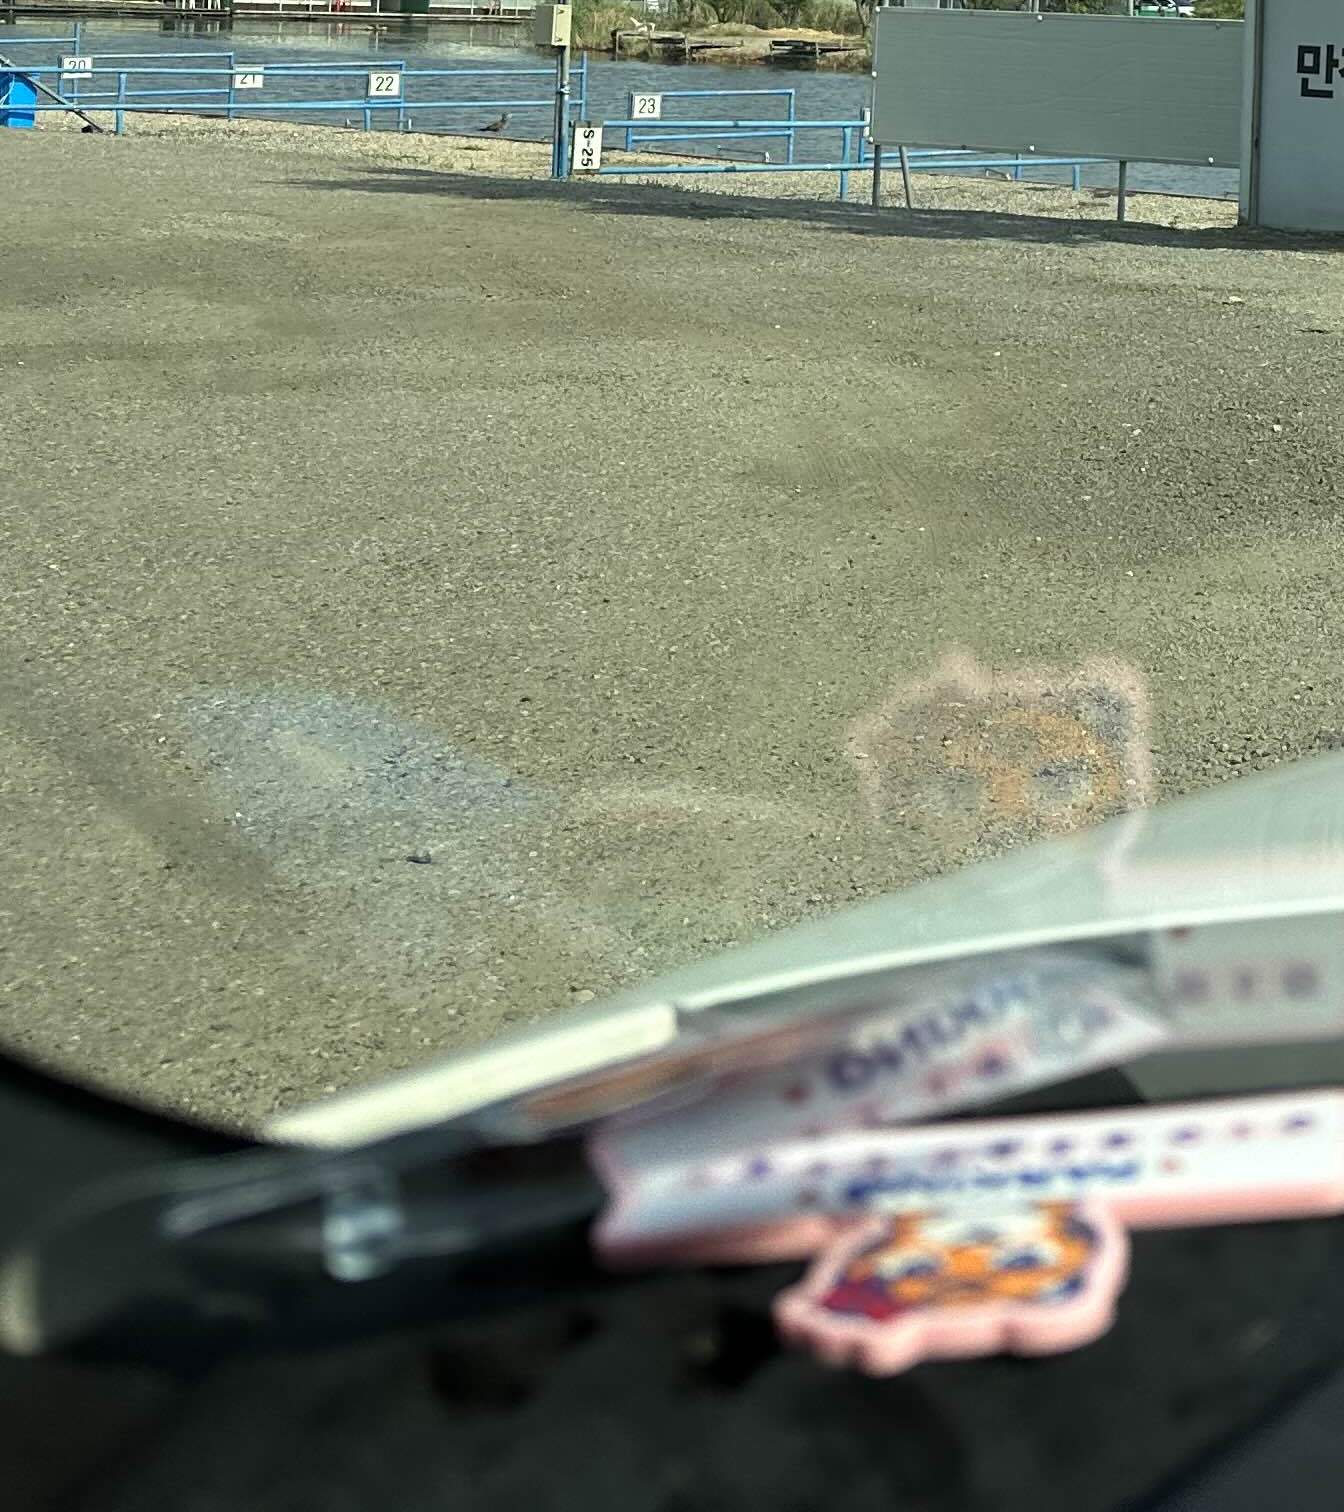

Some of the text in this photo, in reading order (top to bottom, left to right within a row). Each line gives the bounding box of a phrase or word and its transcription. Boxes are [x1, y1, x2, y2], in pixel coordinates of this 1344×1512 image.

[375, 76, 394, 92] 22
[638, 98, 656, 114] 23
[581, 129, 595, 167] S-25
